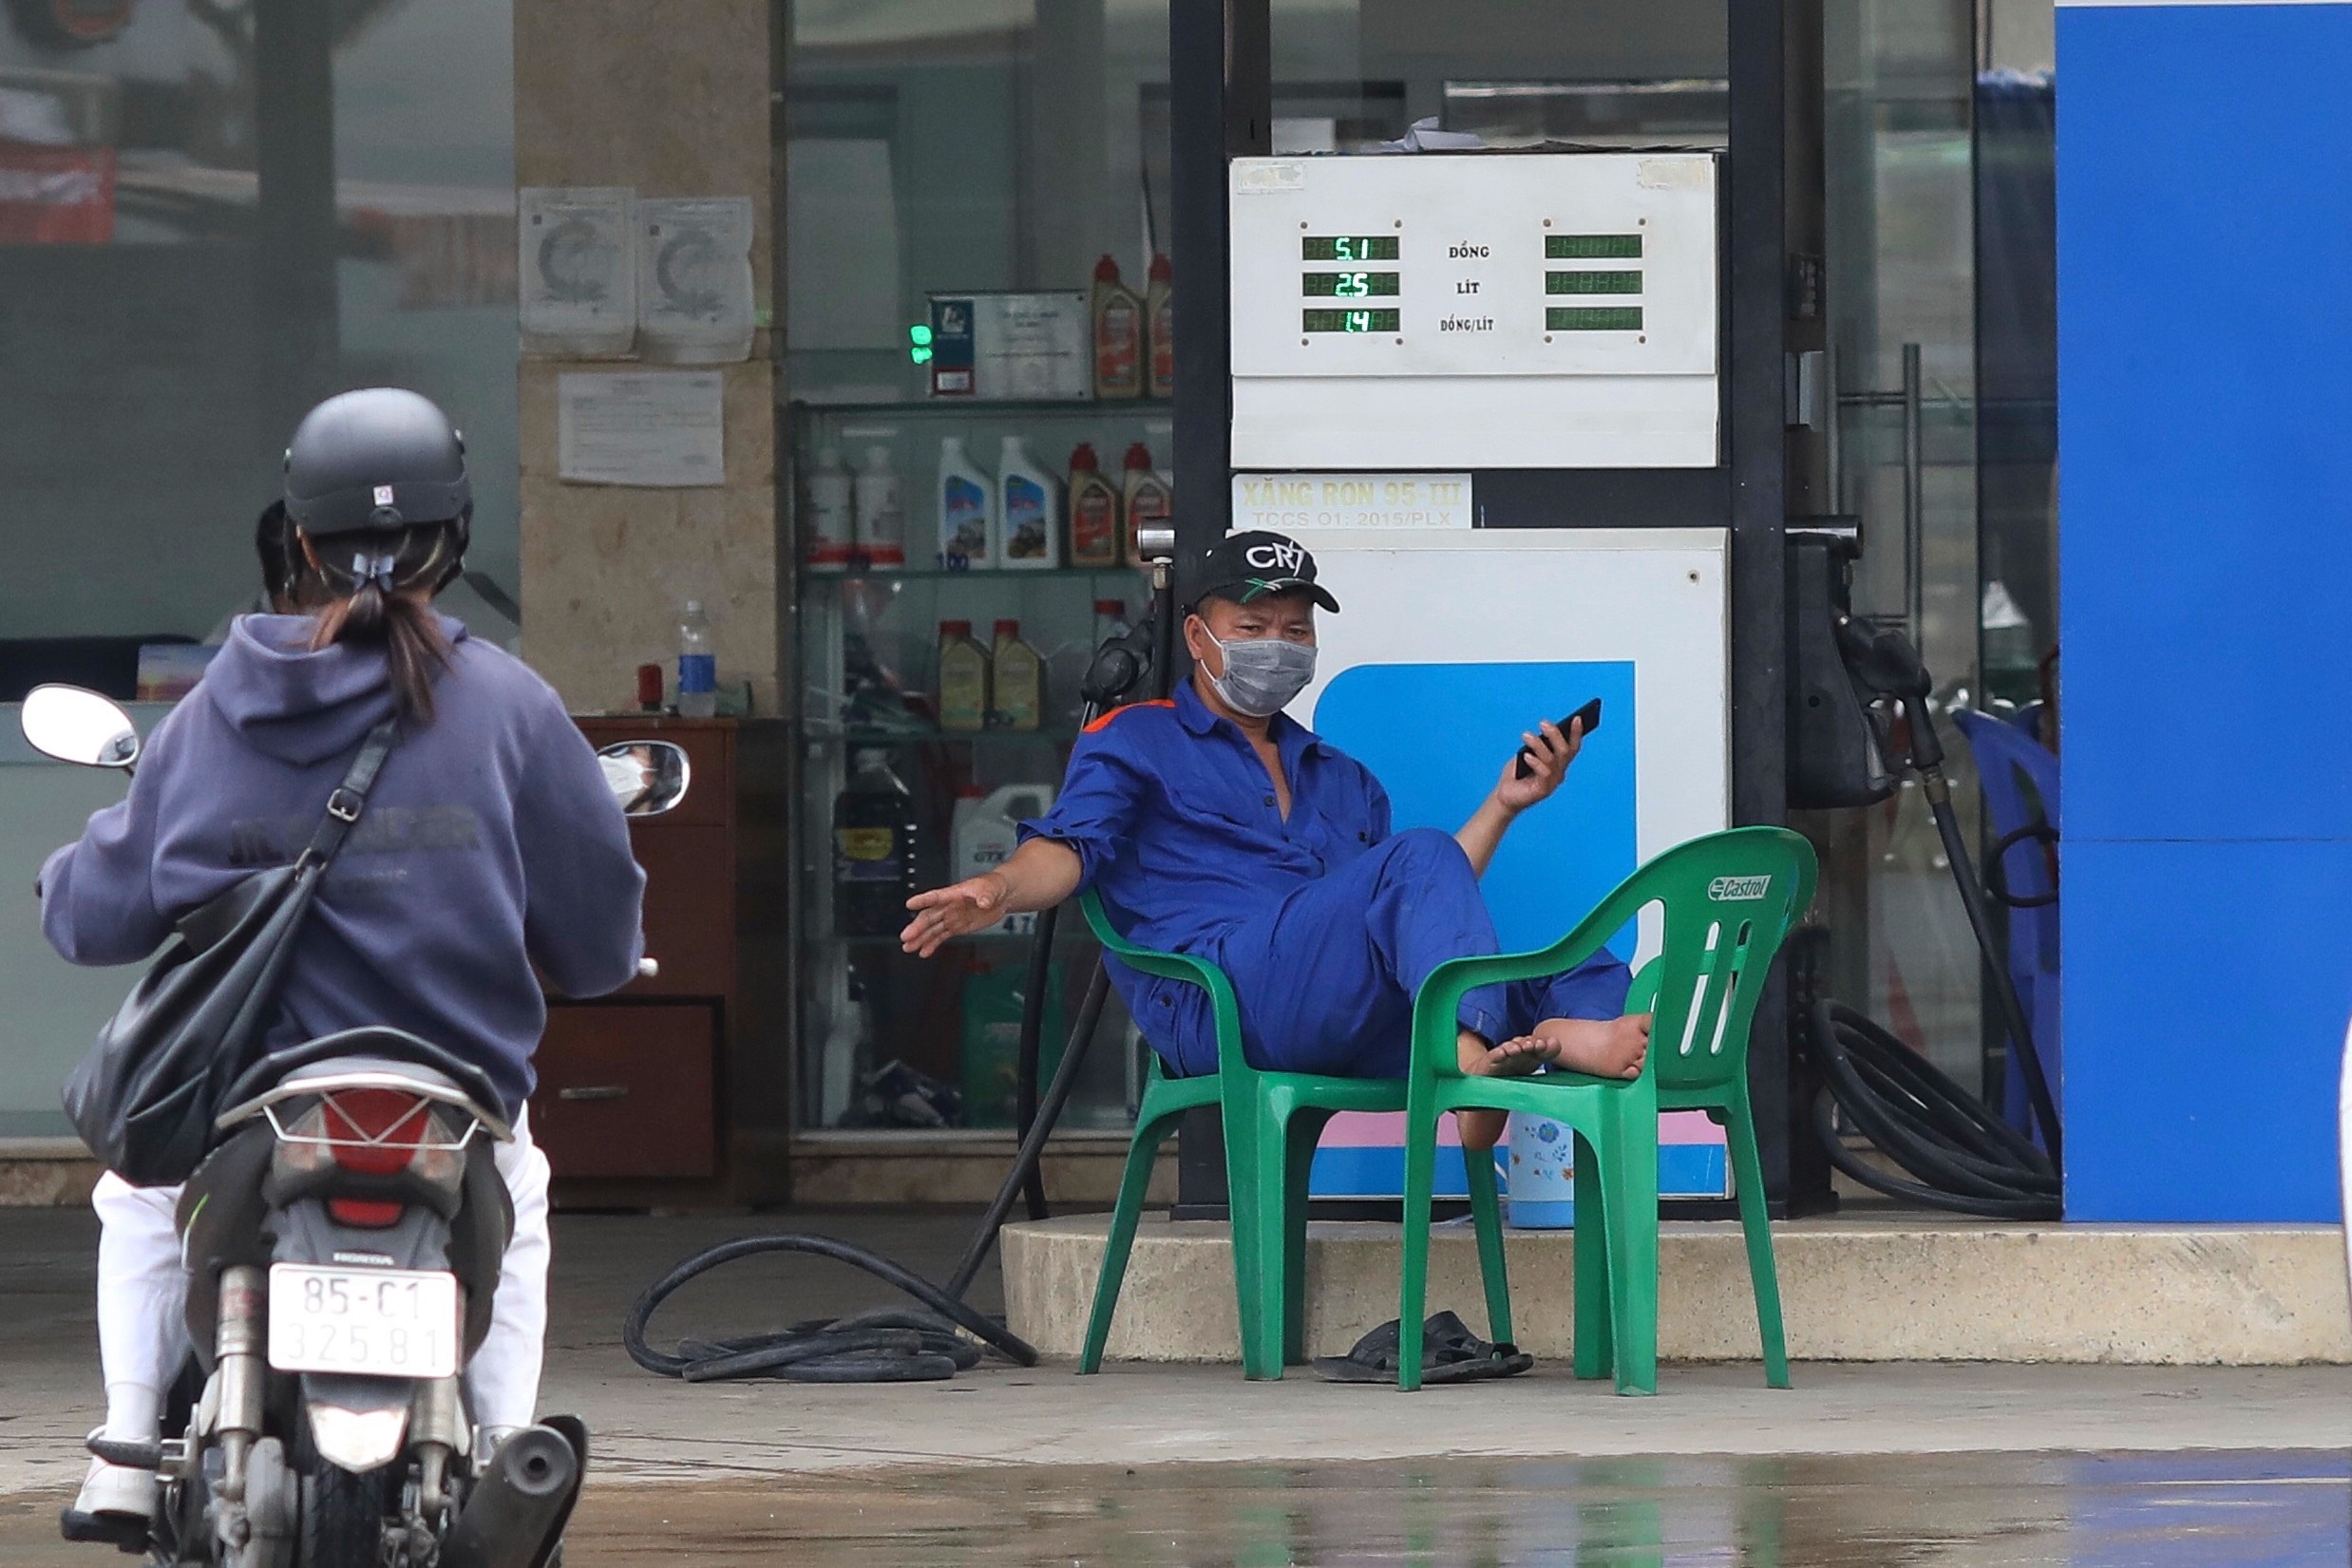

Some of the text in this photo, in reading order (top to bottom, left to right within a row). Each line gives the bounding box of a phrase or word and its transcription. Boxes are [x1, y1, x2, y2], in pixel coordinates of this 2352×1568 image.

[1456, 279, 1480, 294] LÍT
[1242, 478, 1312, 505] XĂNG
[1322, 482, 1375, 505] RON
[1254, 513, 1309, 526] TCCS
[1359, 513, 1451, 526] 2015/PLX
[1723, 878, 1766, 897] Castrol
[304, 1277, 419, 1319] 85-C1
